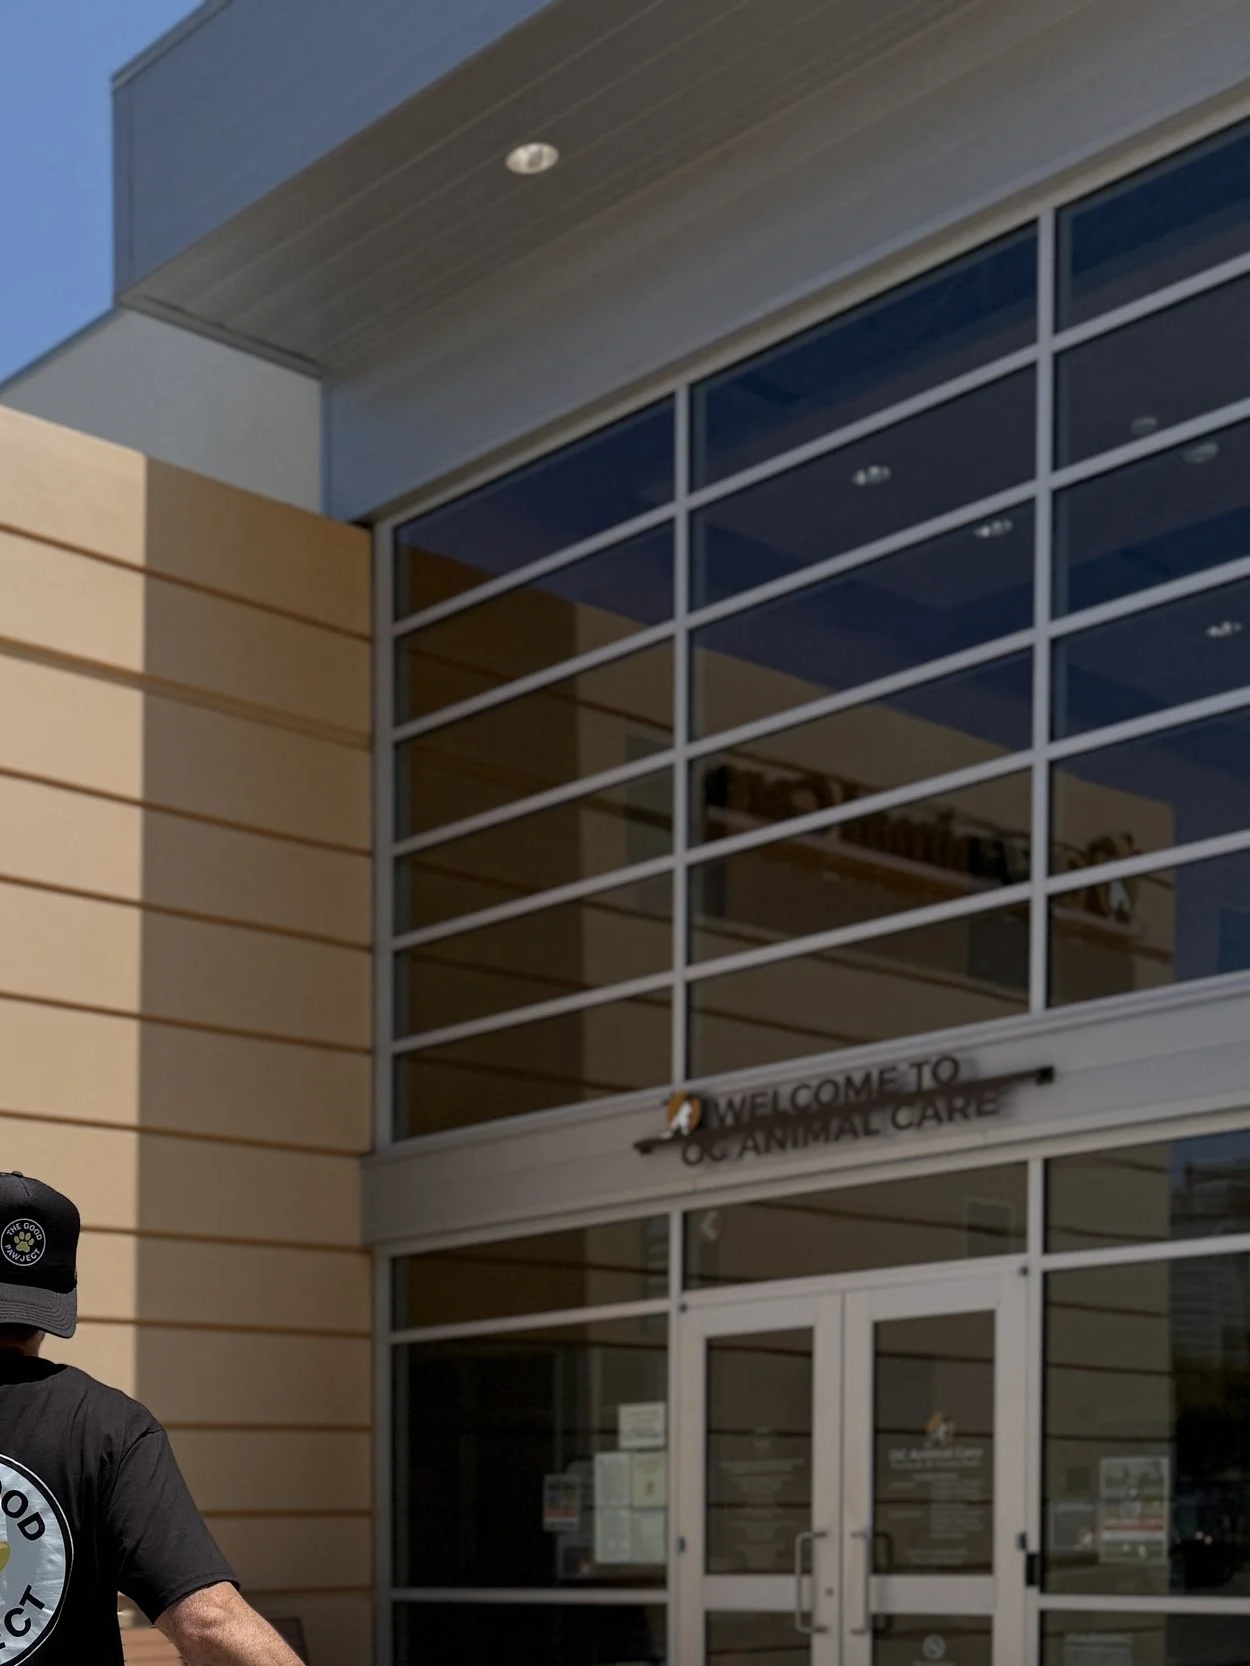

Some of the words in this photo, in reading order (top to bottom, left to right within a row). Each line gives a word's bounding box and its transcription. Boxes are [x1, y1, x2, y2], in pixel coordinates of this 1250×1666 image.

[713, 1065, 898, 1126] WELCOME
[908, 1055, 961, 1091] TO
[681, 1138, 727, 1167] OC
[738, 1110, 881, 1158] ANIMAL
[890, 1089, 1000, 1131] CARE
[4, 1244, 40, 1262] PAWJECT
[6, 1222, 21, 1236] THE
[23, 1222, 42, 1241] GOOD
